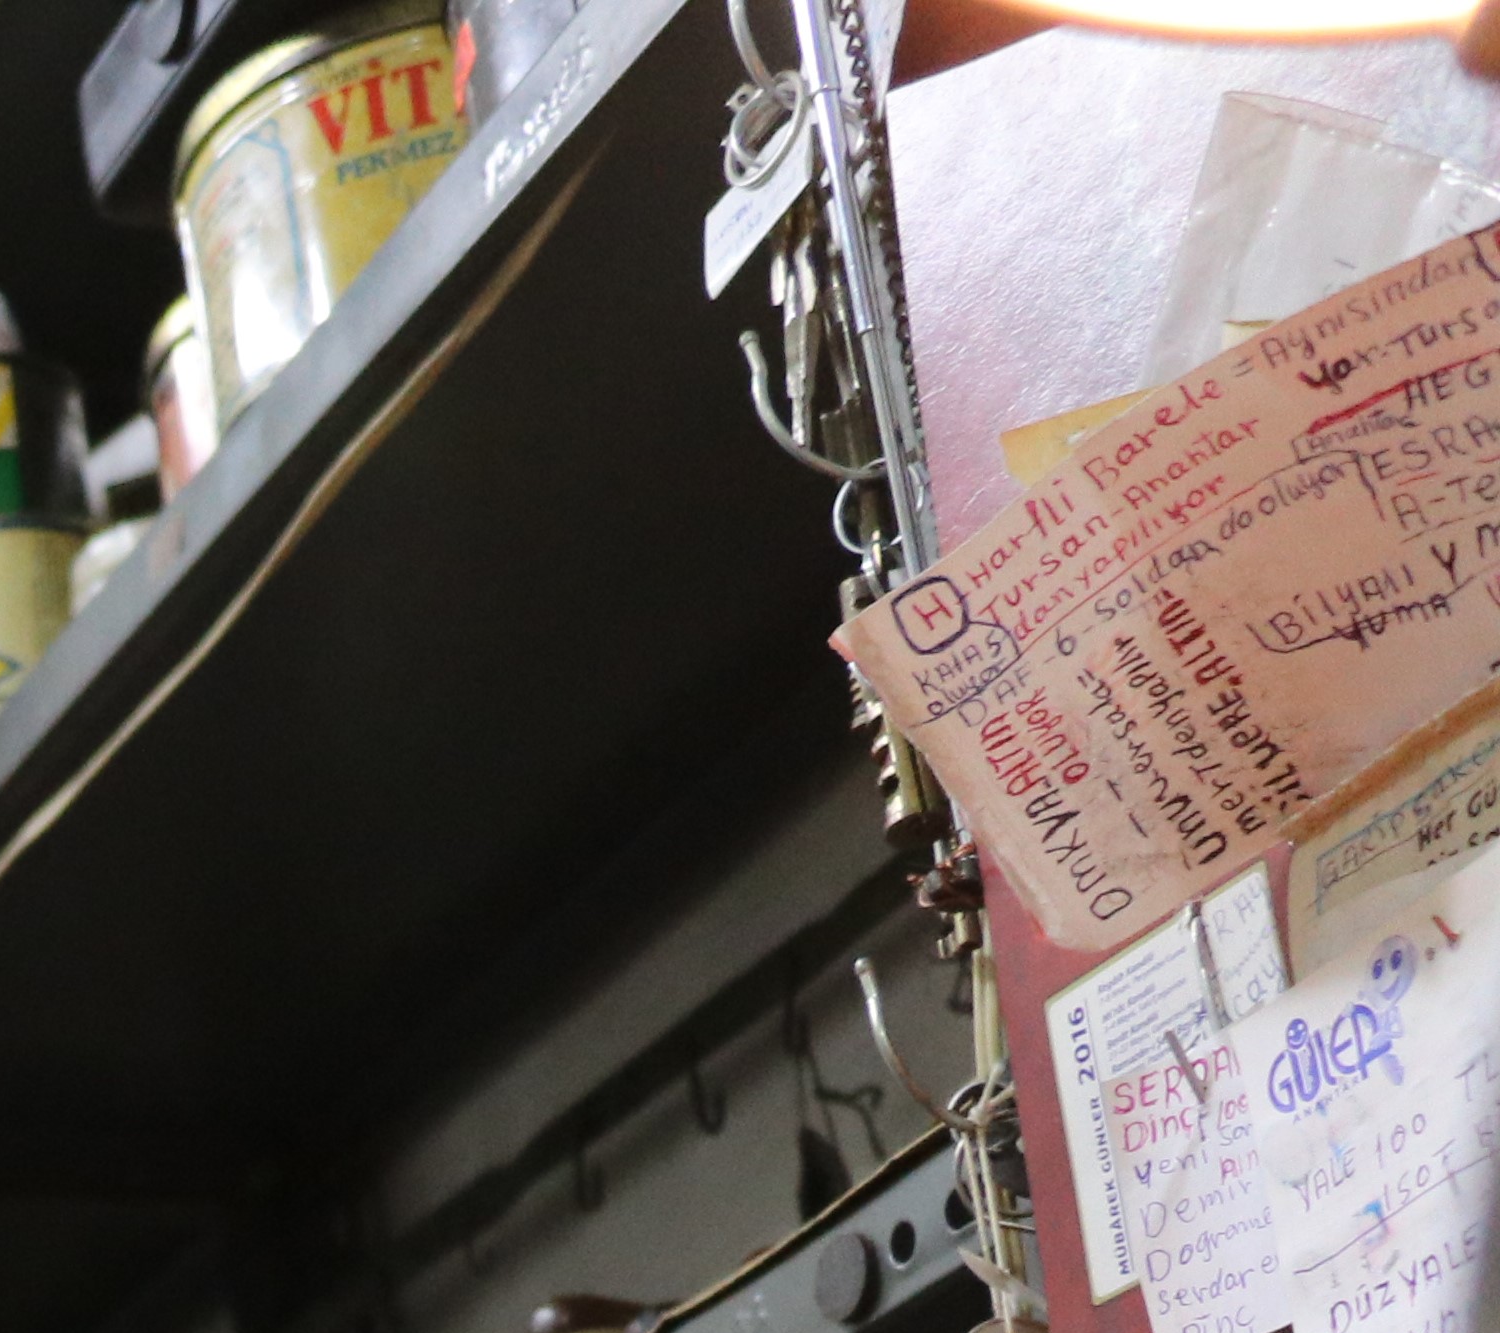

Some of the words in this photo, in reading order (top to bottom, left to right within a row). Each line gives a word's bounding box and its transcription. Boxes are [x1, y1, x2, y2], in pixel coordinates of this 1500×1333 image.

[307, 57, 466, 157] VİT
[336, 130, 460, 186] PEKMEZ
[912, 591, 954, 631] H
[1067, 1006, 1096, 1086] 2016
[1267, 1003, 1393, 1114] GÜLER
